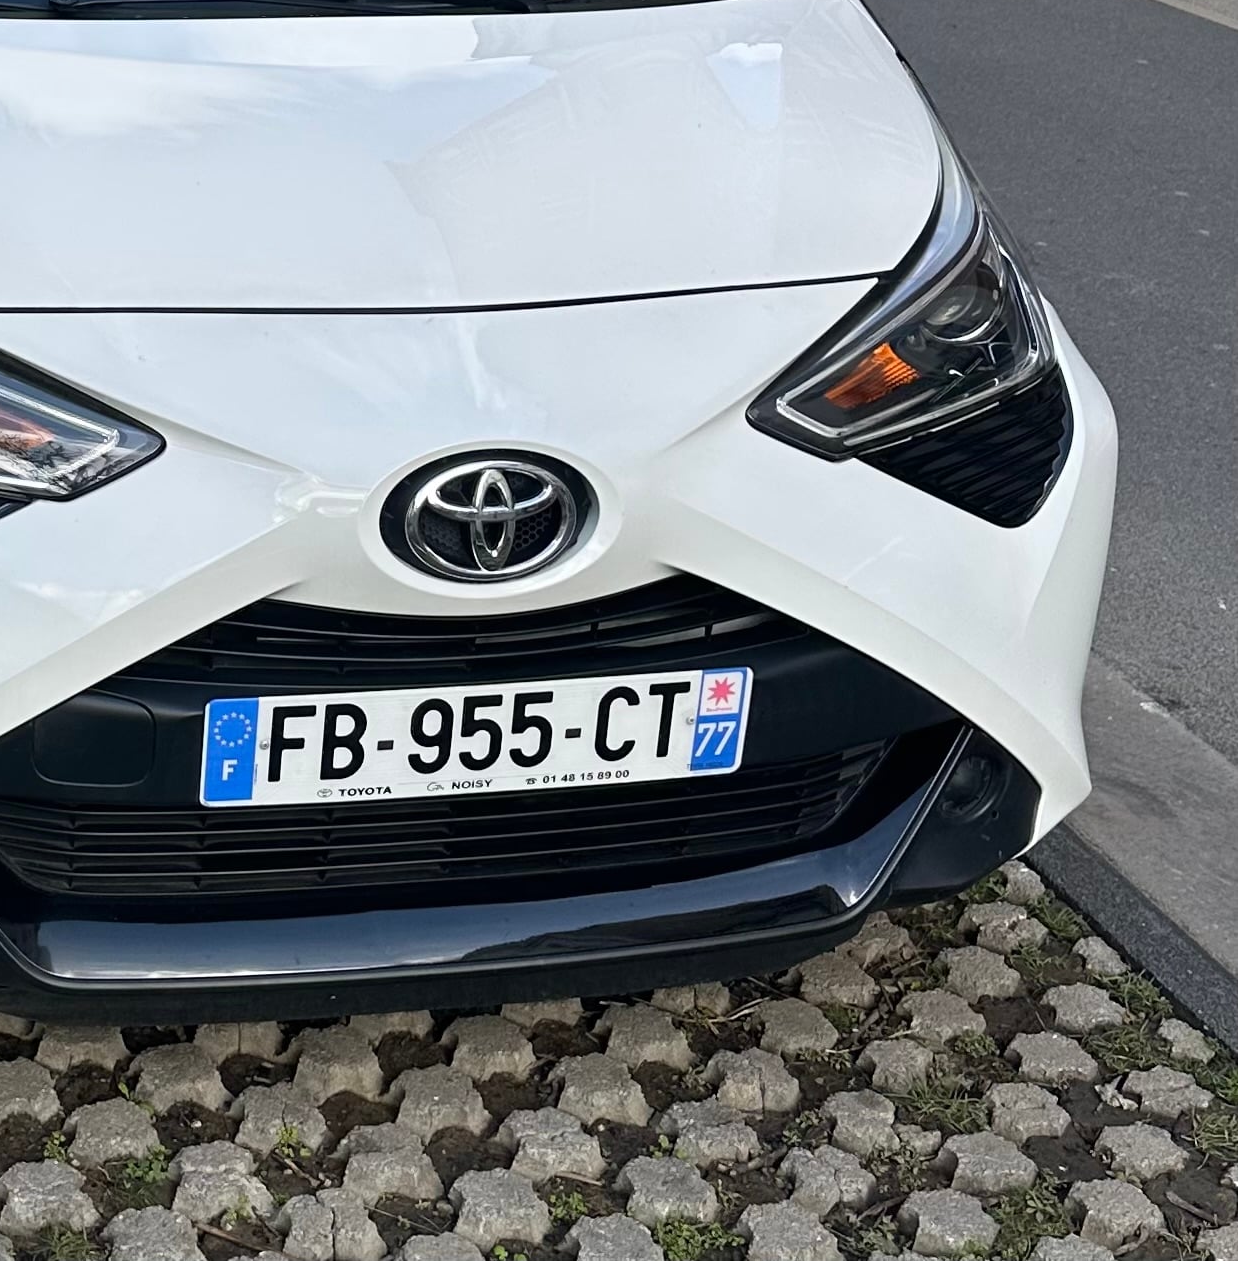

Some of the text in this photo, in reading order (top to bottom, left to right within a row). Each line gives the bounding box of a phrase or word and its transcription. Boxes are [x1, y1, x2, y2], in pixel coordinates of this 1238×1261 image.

[268, 681, 691, 783] FB-955-CT
[694, 720, 737, 757] 77
[221, 759, 238, 781] F
[339, 786, 392, 797] TOYOTA
[452, 779, 493, 790] NOISY
[542, 775, 556, 784] 01
[561, 773, 575, 782] 48
[580, 772, 594, 781] 15
[597, 771, 611, 780] 89
[615, 769, 630, 779] 00
